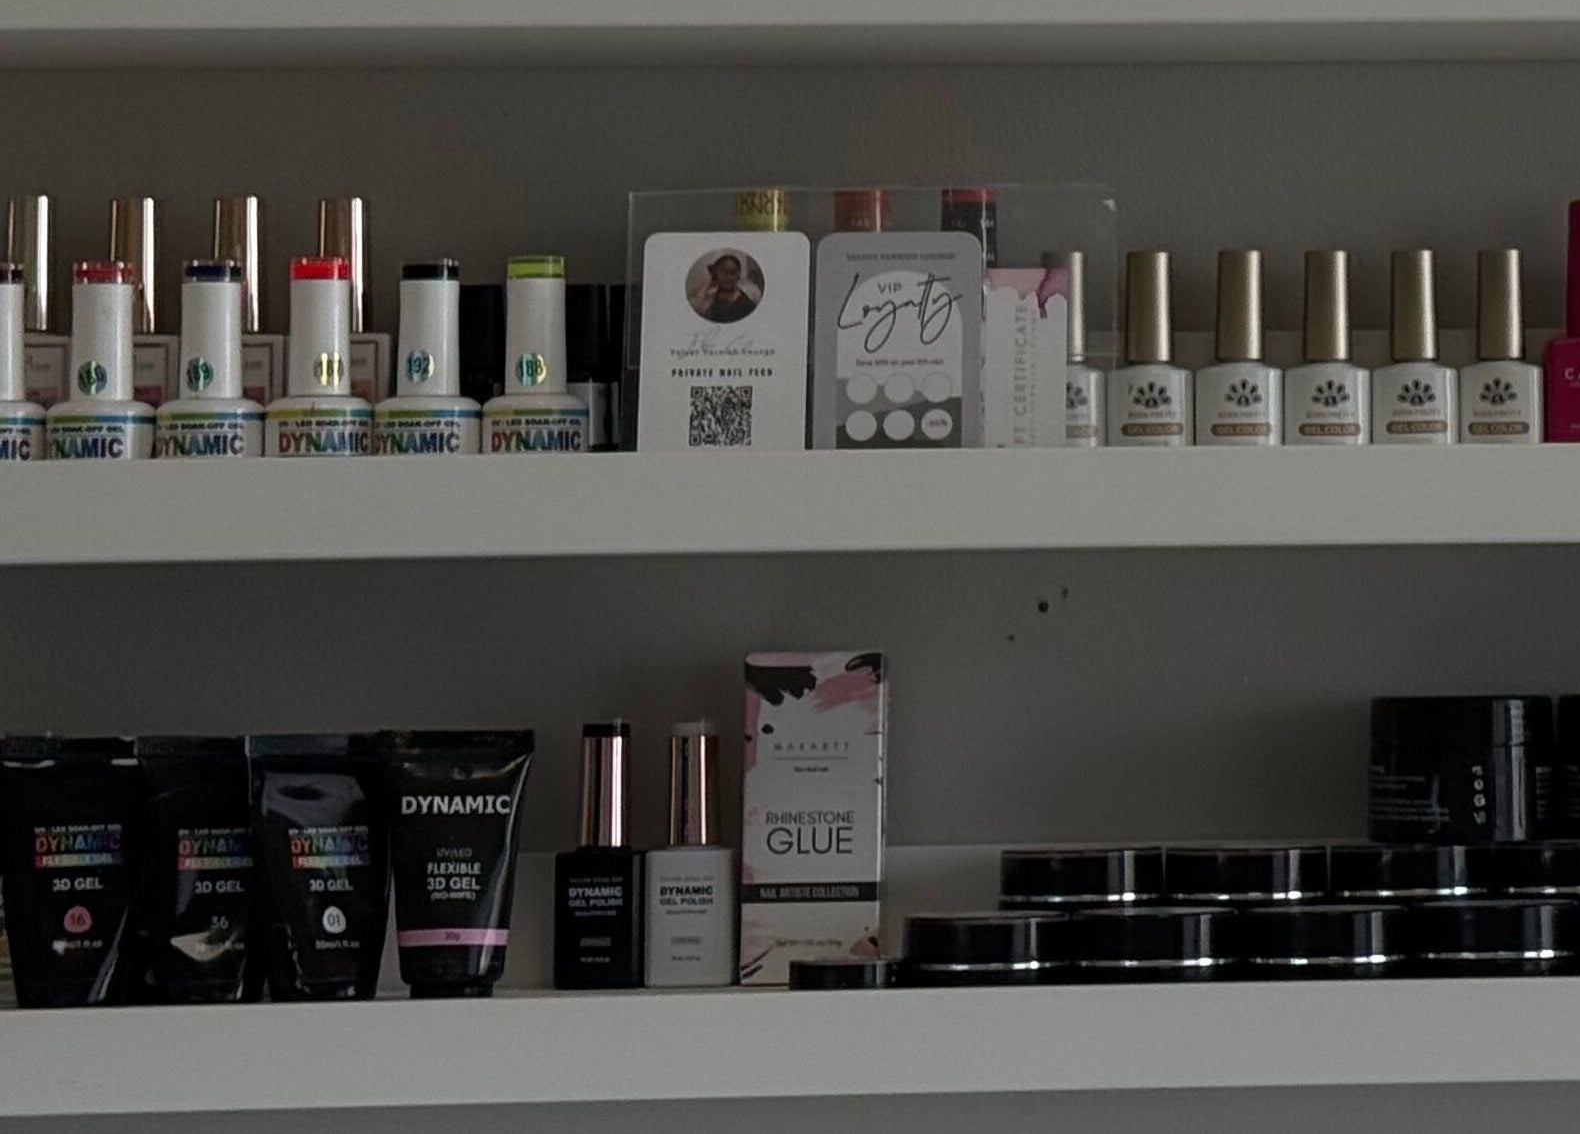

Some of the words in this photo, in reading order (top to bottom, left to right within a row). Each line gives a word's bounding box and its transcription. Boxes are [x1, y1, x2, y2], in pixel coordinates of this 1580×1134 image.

[877, 282, 903, 295] VIP
[837, 271, 963, 354] Loyalty
[405, 356, 431, 376] 192
[1014, 304, 1028, 417] CERTIFICATE
[279, 431, 368, 452] DYNAMIC
[375, 431, 460, 453] DYNAMIC
[491, 429, 581, 451] DYNAMIC
[52, 437, 124, 460] NAMIC
[402, 794, 512, 816] DYNAMIC
[765, 810, 855, 825] RHINESTONE
[34, 833, 122, 853] DYNAMIC
[766, 826, 854, 855] GLUE
[427, 862, 482, 876] FLEXIBLE
[51, 879, 71, 892] 3D
[74, 877, 104, 891] GEL
[194, 880, 212, 894] 3D
[215, 879, 246, 893] GEL
[309, 878, 325, 892] 3D
[327, 877, 354, 891] GEL
[426, 877, 447, 890] 3D
[449, 877, 482, 890] GEL
[659, 885, 714, 896] DYNAMIC
[568, 886, 623, 898] DYNAMIC
[567, 898, 588, 908] GEL
[589, 897, 624, 908] POLISH
[659, 897, 679, 906] GEL
[680, 897, 714, 906] POLISH
[70, 912, 85, 926] 16
[327, 915, 342, 927] 01
